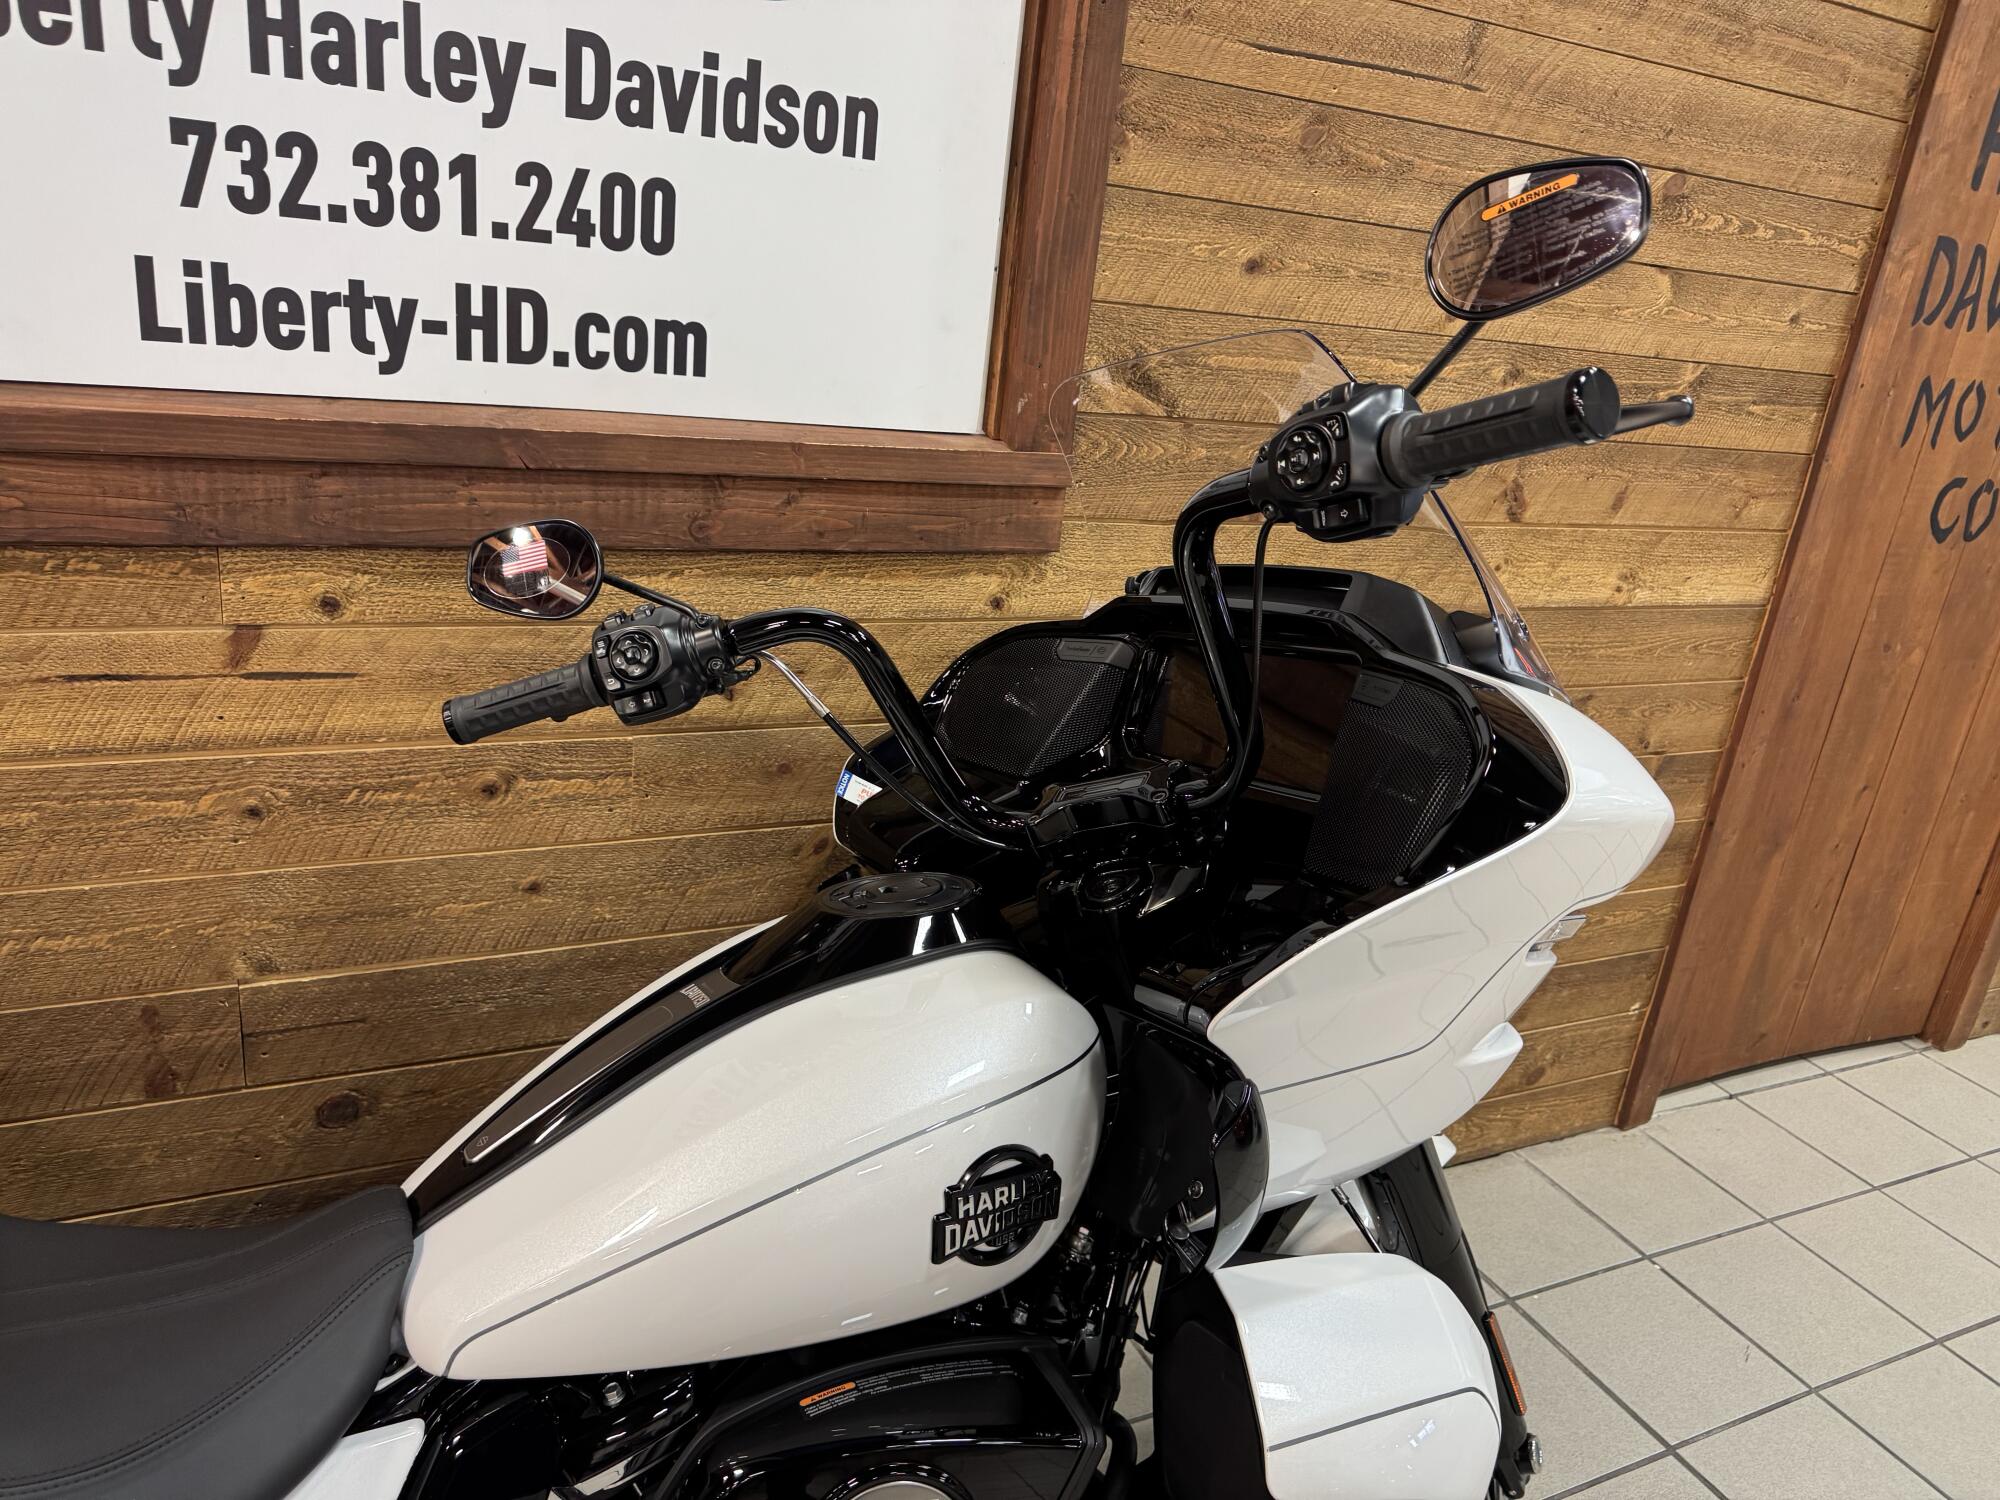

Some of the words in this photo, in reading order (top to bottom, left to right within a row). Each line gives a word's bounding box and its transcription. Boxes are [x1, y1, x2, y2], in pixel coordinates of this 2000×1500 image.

[0, 0, 214, 87] erty
[247, 0, 879, 161] Harley-Davidson
[170, 117, 677, 255] 732.381.2400
[1509, 182, 1561, 209] WARNING
[134, 255, 708, 377] Liberty-HD.com
[1900, 375, 2000, 452] MO
[1929, 477, 2000, 545] CO
